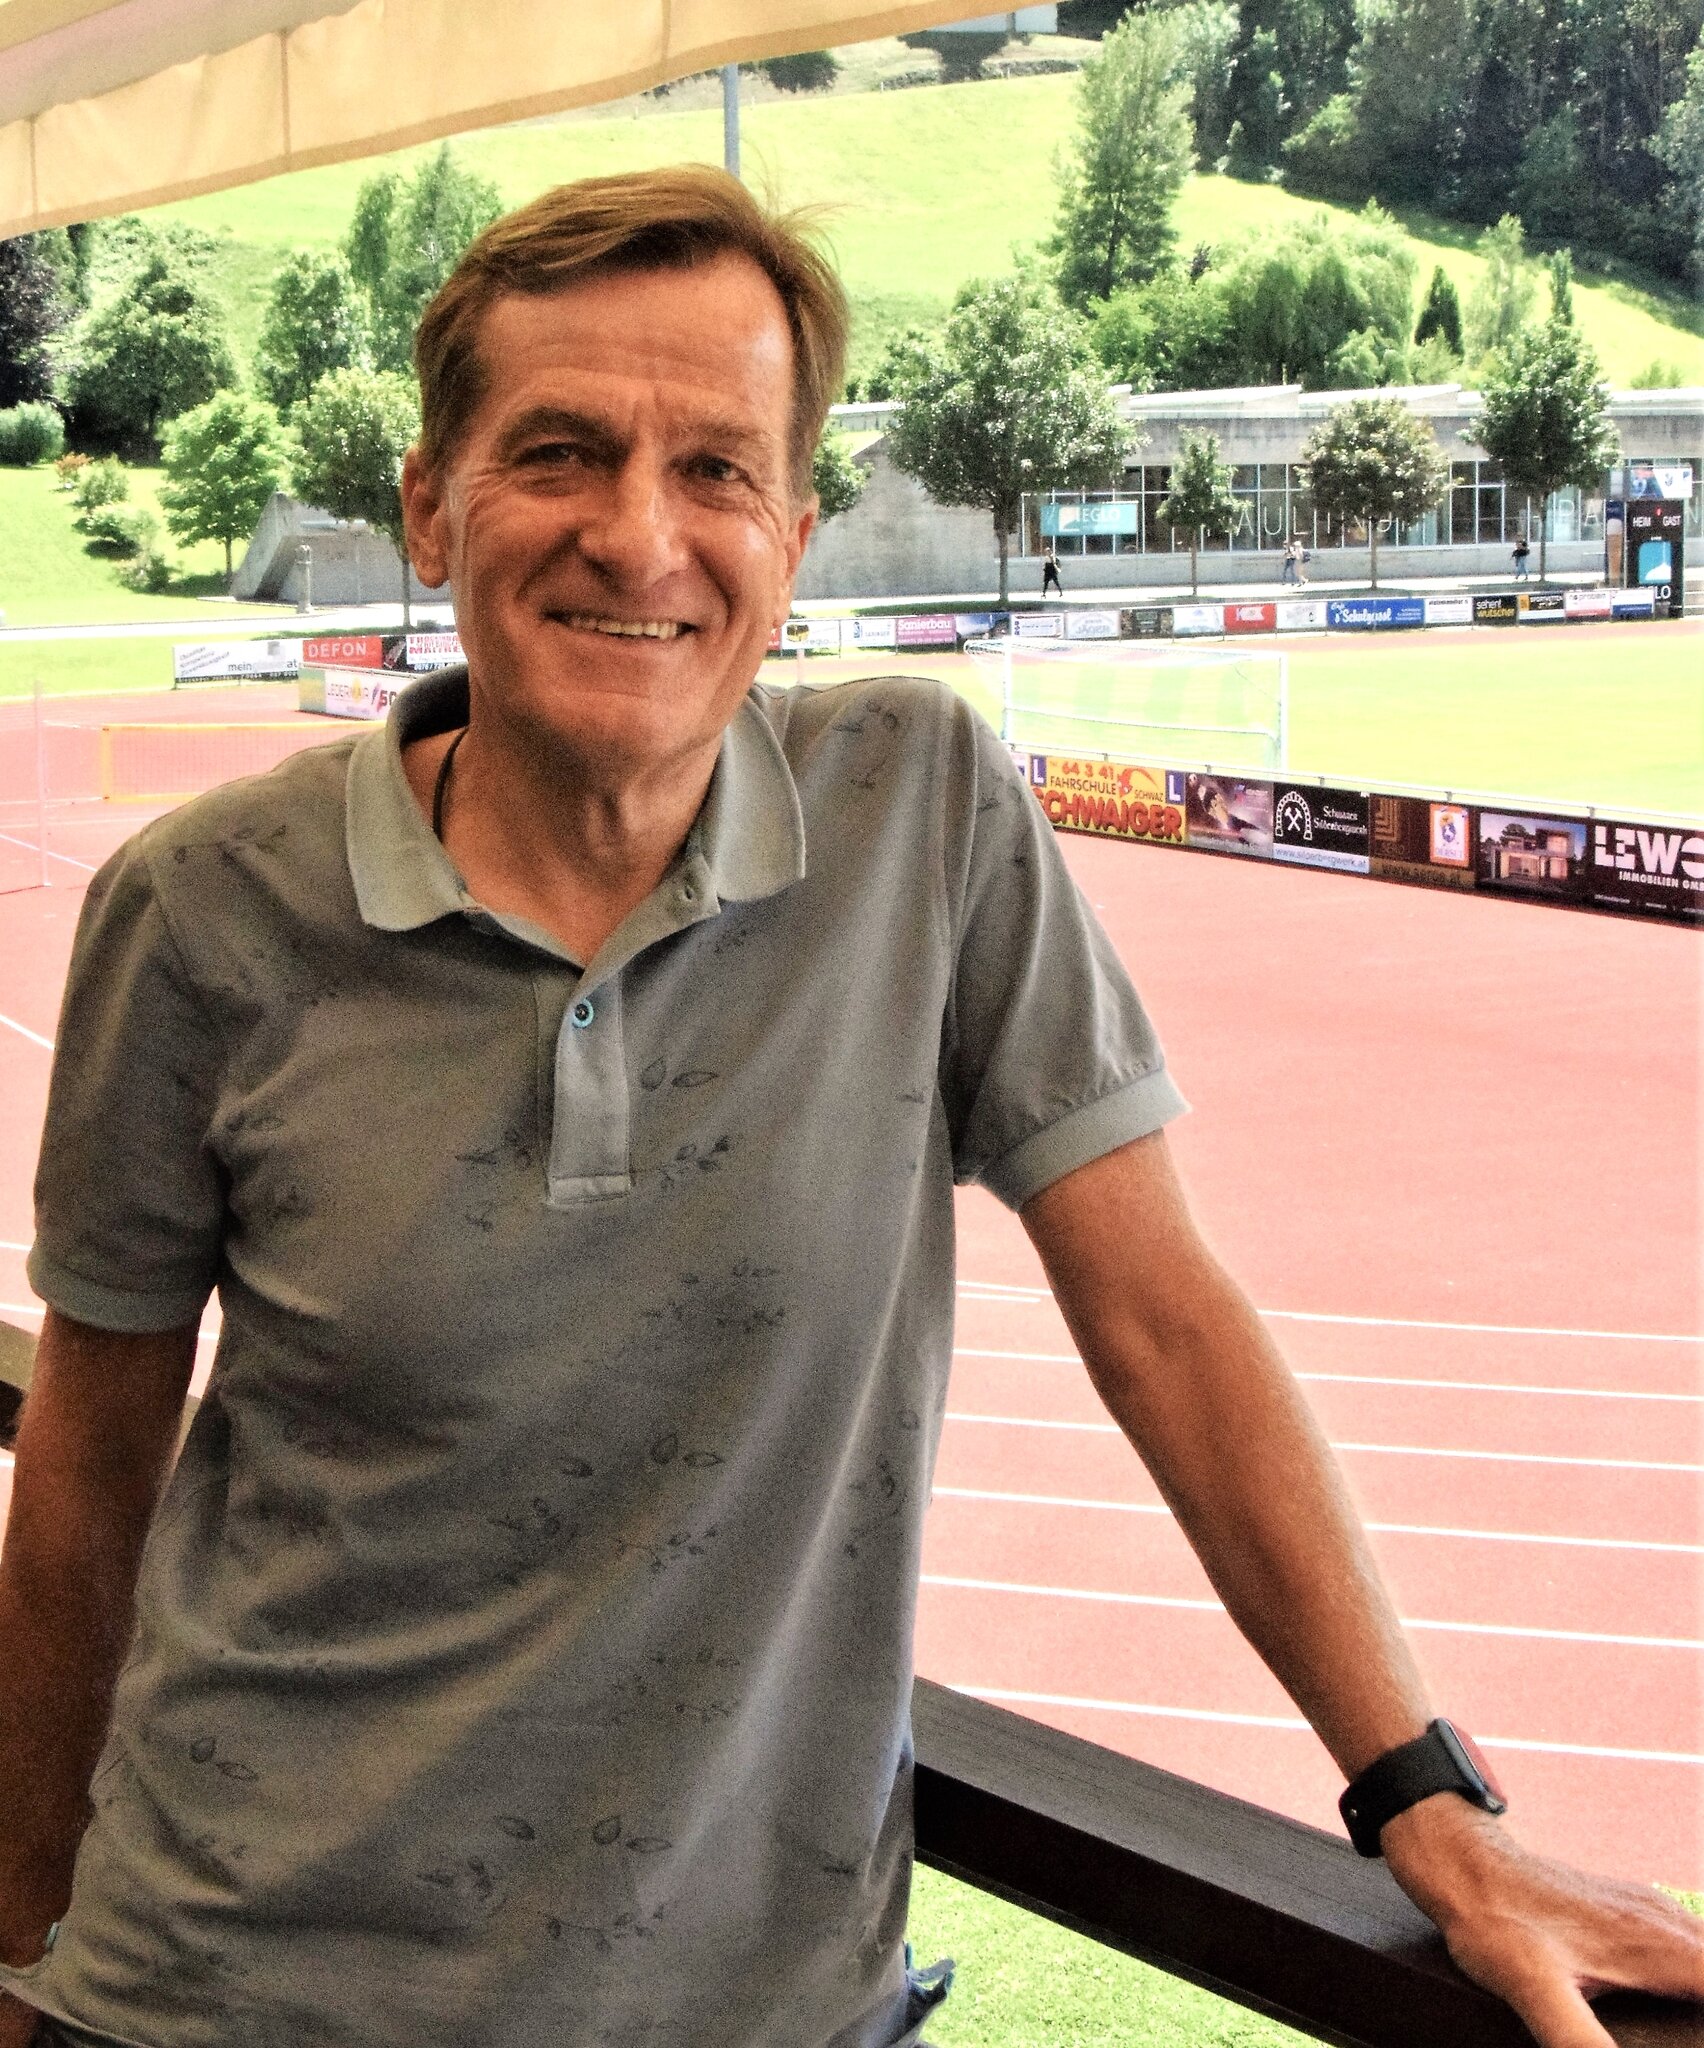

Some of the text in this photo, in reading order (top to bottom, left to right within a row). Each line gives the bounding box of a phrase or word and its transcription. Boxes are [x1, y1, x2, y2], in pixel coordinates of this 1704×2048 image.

[1632, 516, 1651, 527] HEIM
[1662, 515, 1681, 527] GAST
[898, 619, 951, 631] Sanierbau
[308, 642, 367, 658] DEFON
[227, 661, 253, 672] mein
[1033, 758, 1045, 784] L
[1061, 761, 1115, 780] 64 3 41
[1050, 775, 1117, 796] FAHRSCHULE
[1168, 774, 1182, 801] L
[1134, 789, 1164, 803] SCHWAZ
[1618, 870, 1680, 889] IMMOBILIEN
